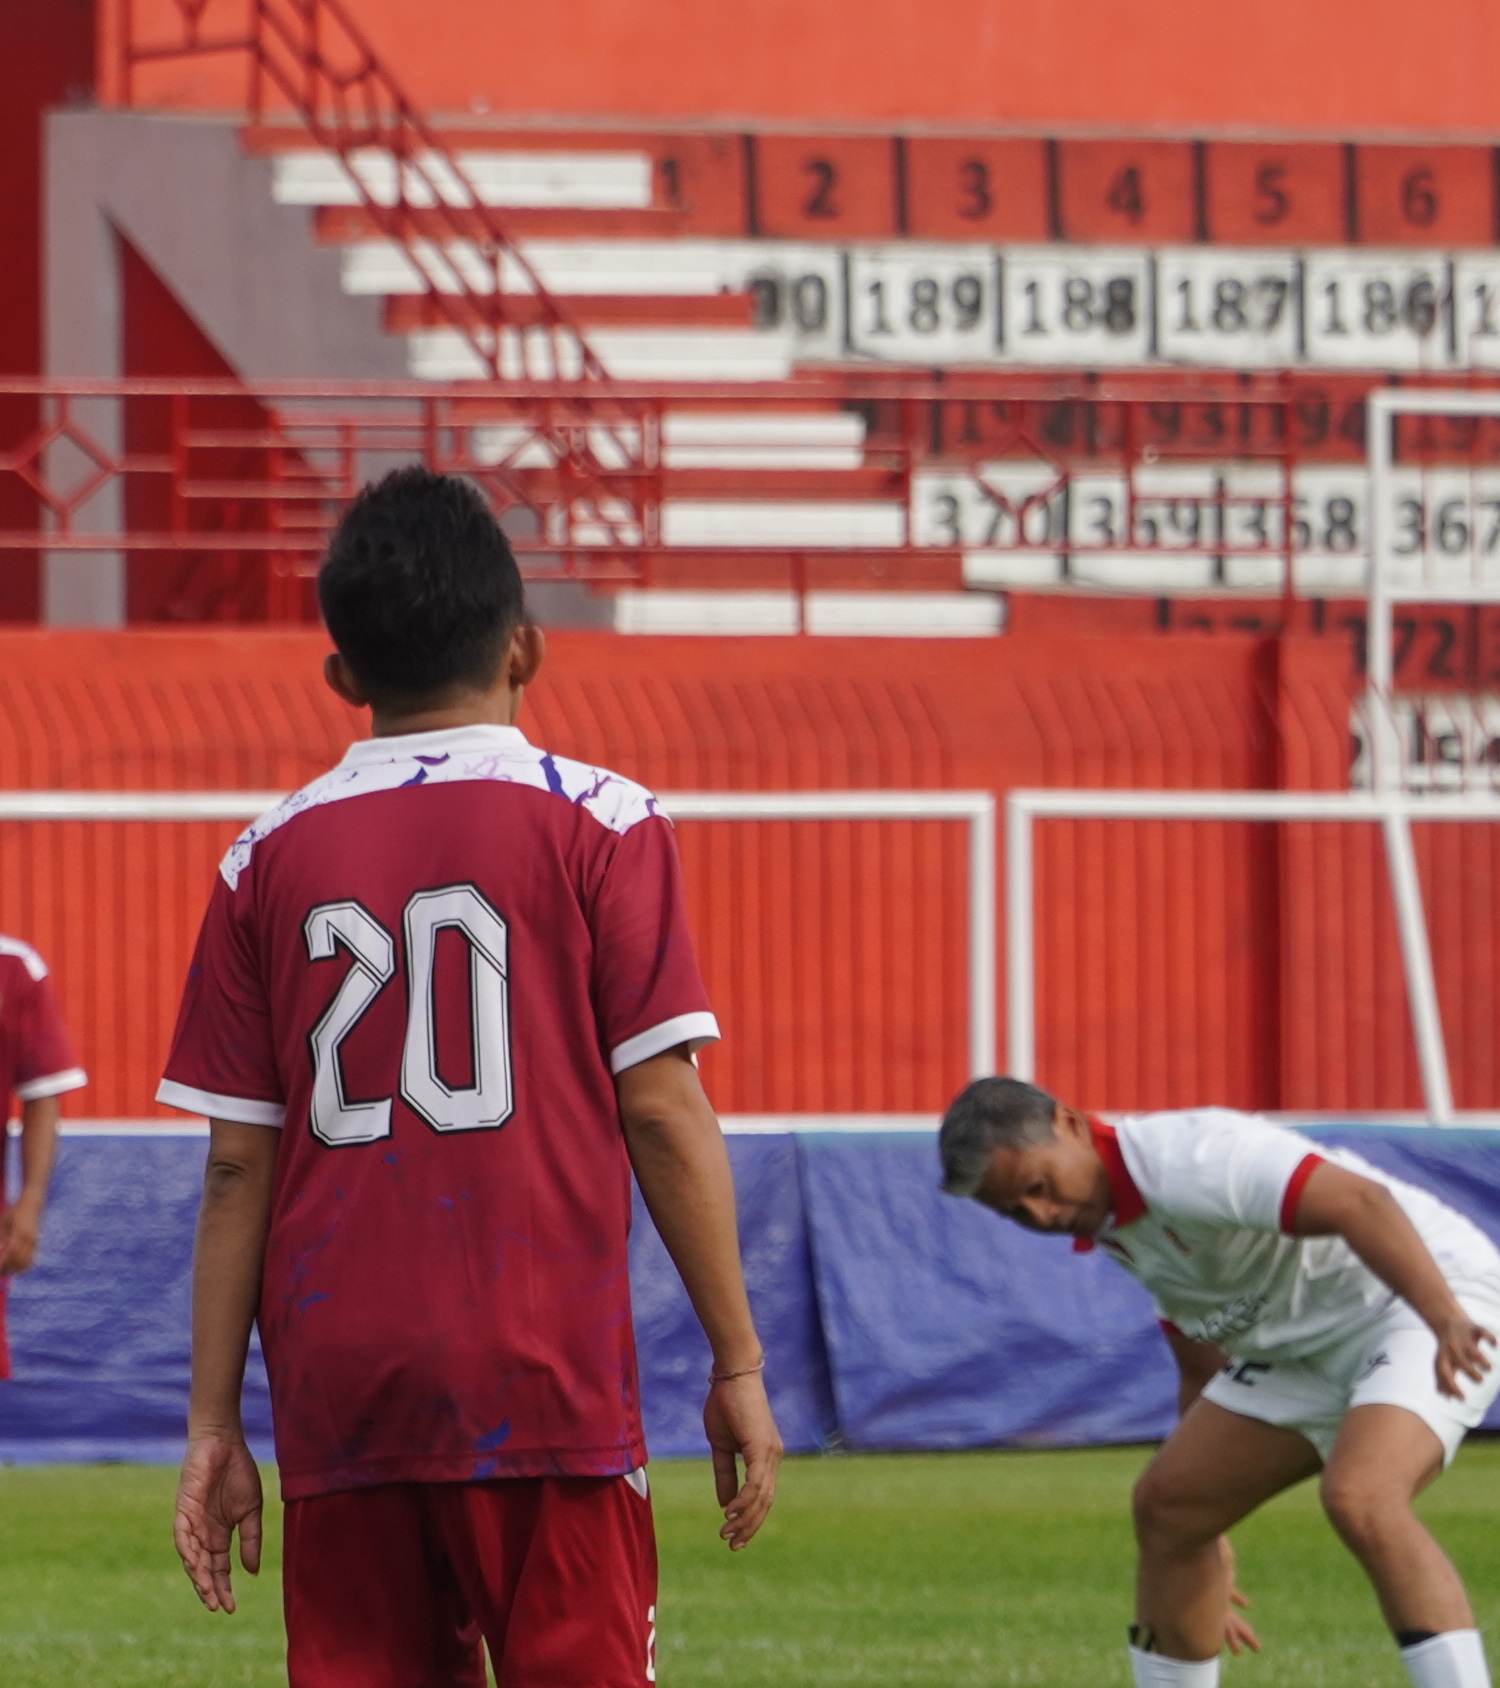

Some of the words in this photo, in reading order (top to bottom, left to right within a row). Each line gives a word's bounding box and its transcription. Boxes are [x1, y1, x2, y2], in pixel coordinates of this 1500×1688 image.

[661, 160, 682, 208] 1
[805, 160, 838, 219] 2
[957, 160, 993, 220] 3
[1106, 165, 1144, 225] 4
[1253, 167, 1291, 224] 5
[1402, 166, 1438, 228] 6
[869, 275, 984, 337] 189
[1021, 275, 1138, 337] 188
[1175, 276, 1289, 337] 187
[1322, 278, 1437, 338] 186
[301, 880, 514, 1150] 20
